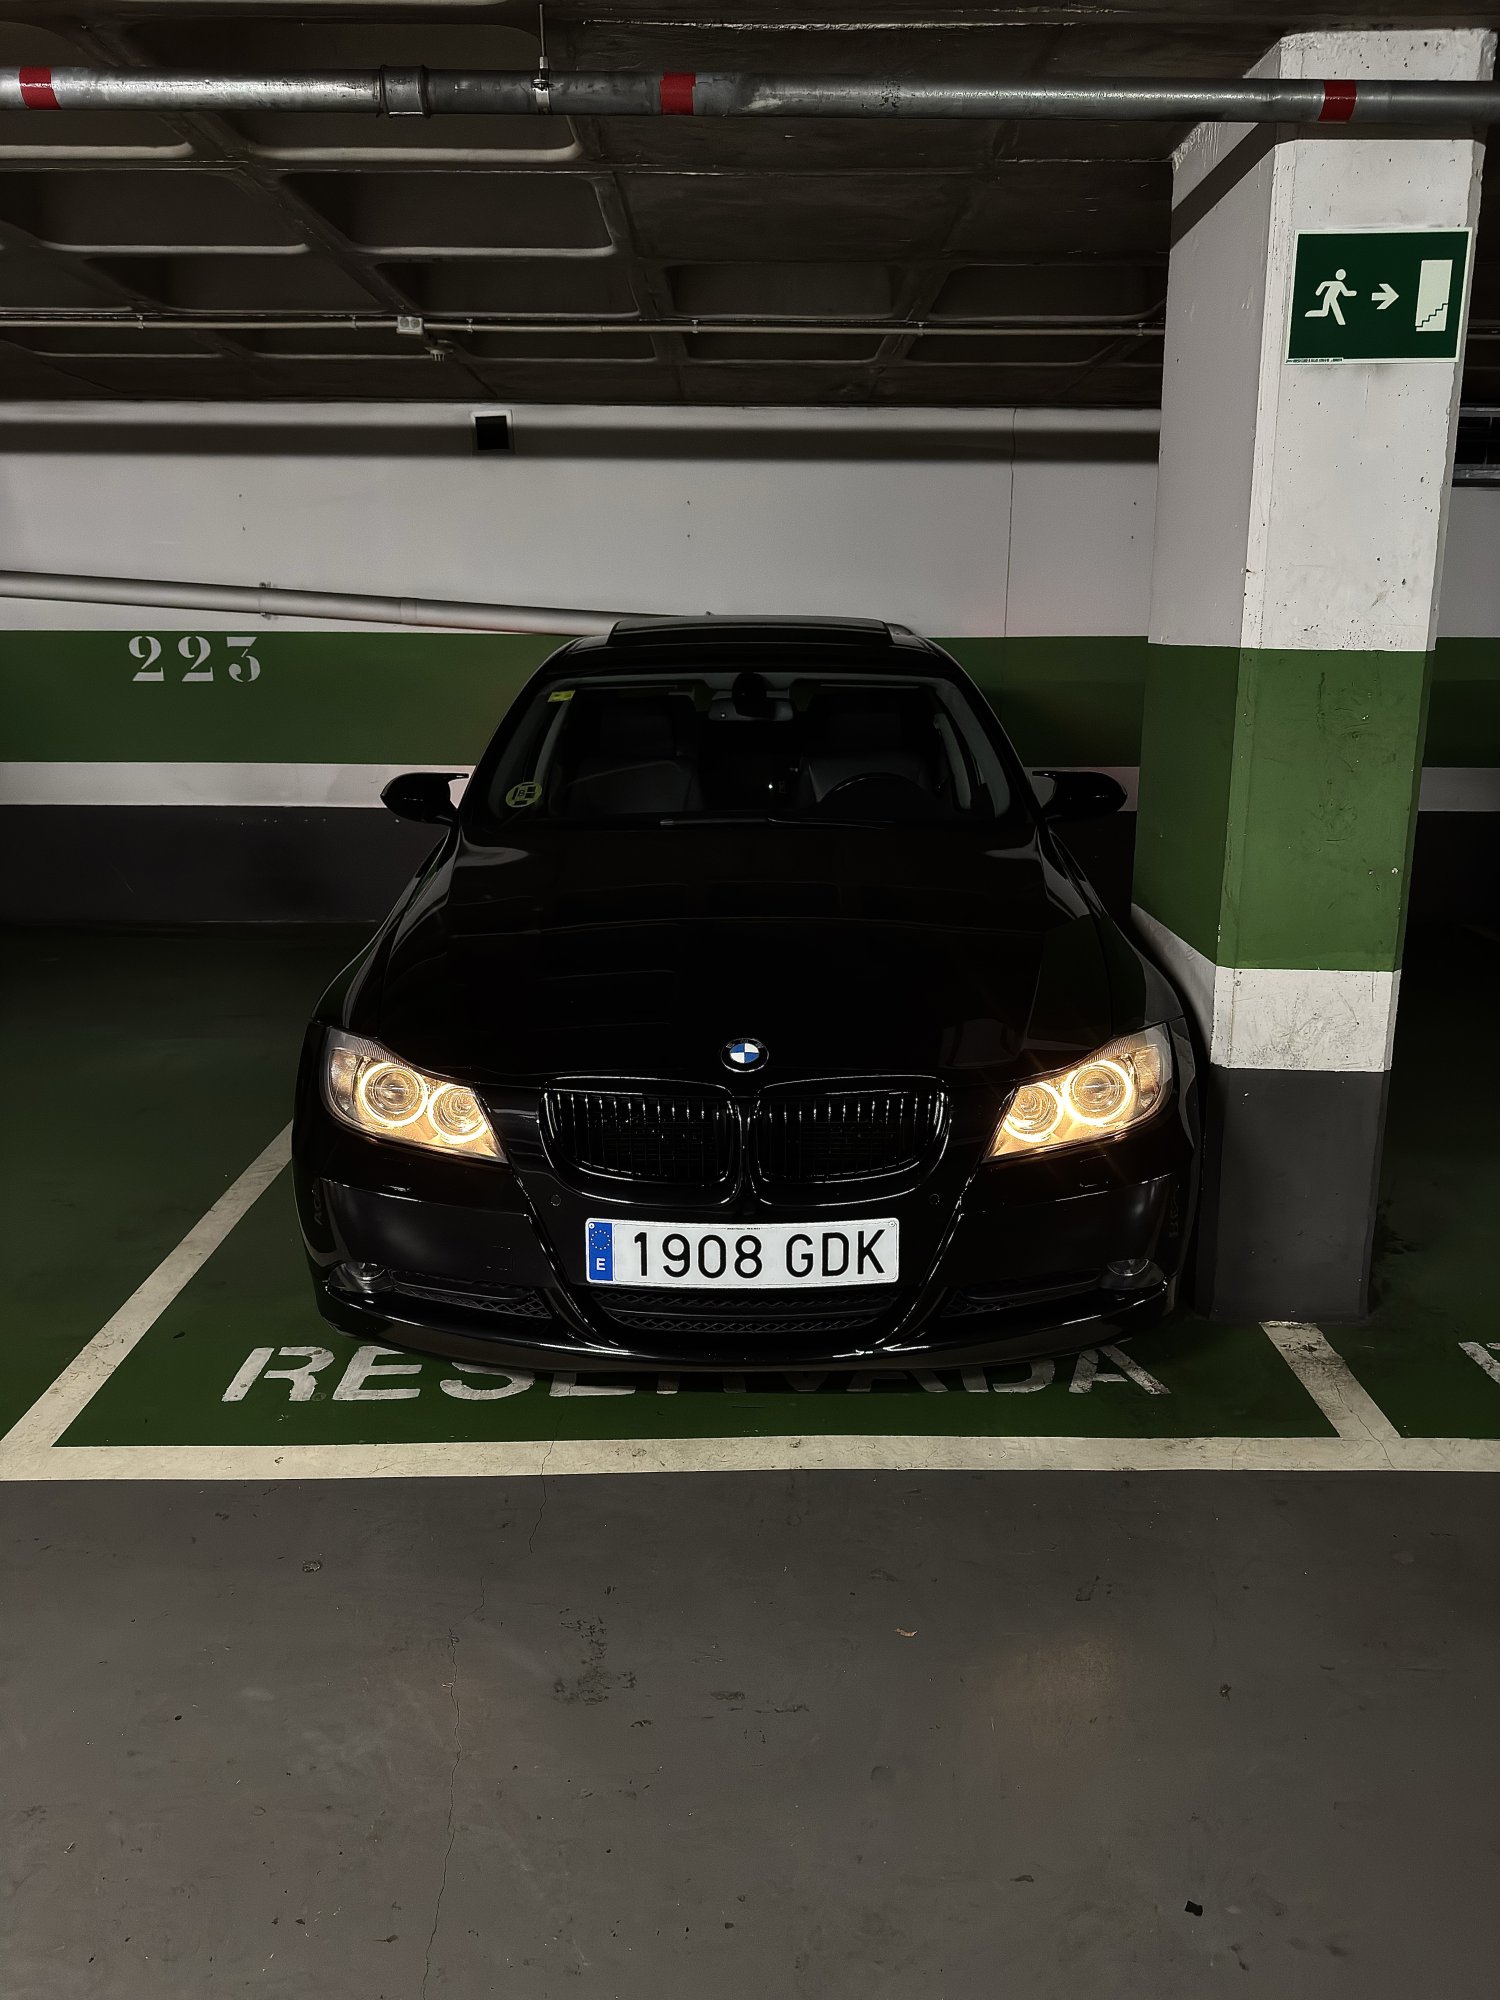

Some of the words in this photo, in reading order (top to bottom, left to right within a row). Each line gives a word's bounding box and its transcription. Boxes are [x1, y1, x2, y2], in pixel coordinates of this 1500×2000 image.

[128, 635, 262, 683] 223
[596, 1257, 607, 1272] E
[633, 1231, 763, 1279] 1908
[786, 1229, 885, 1278] GDK
